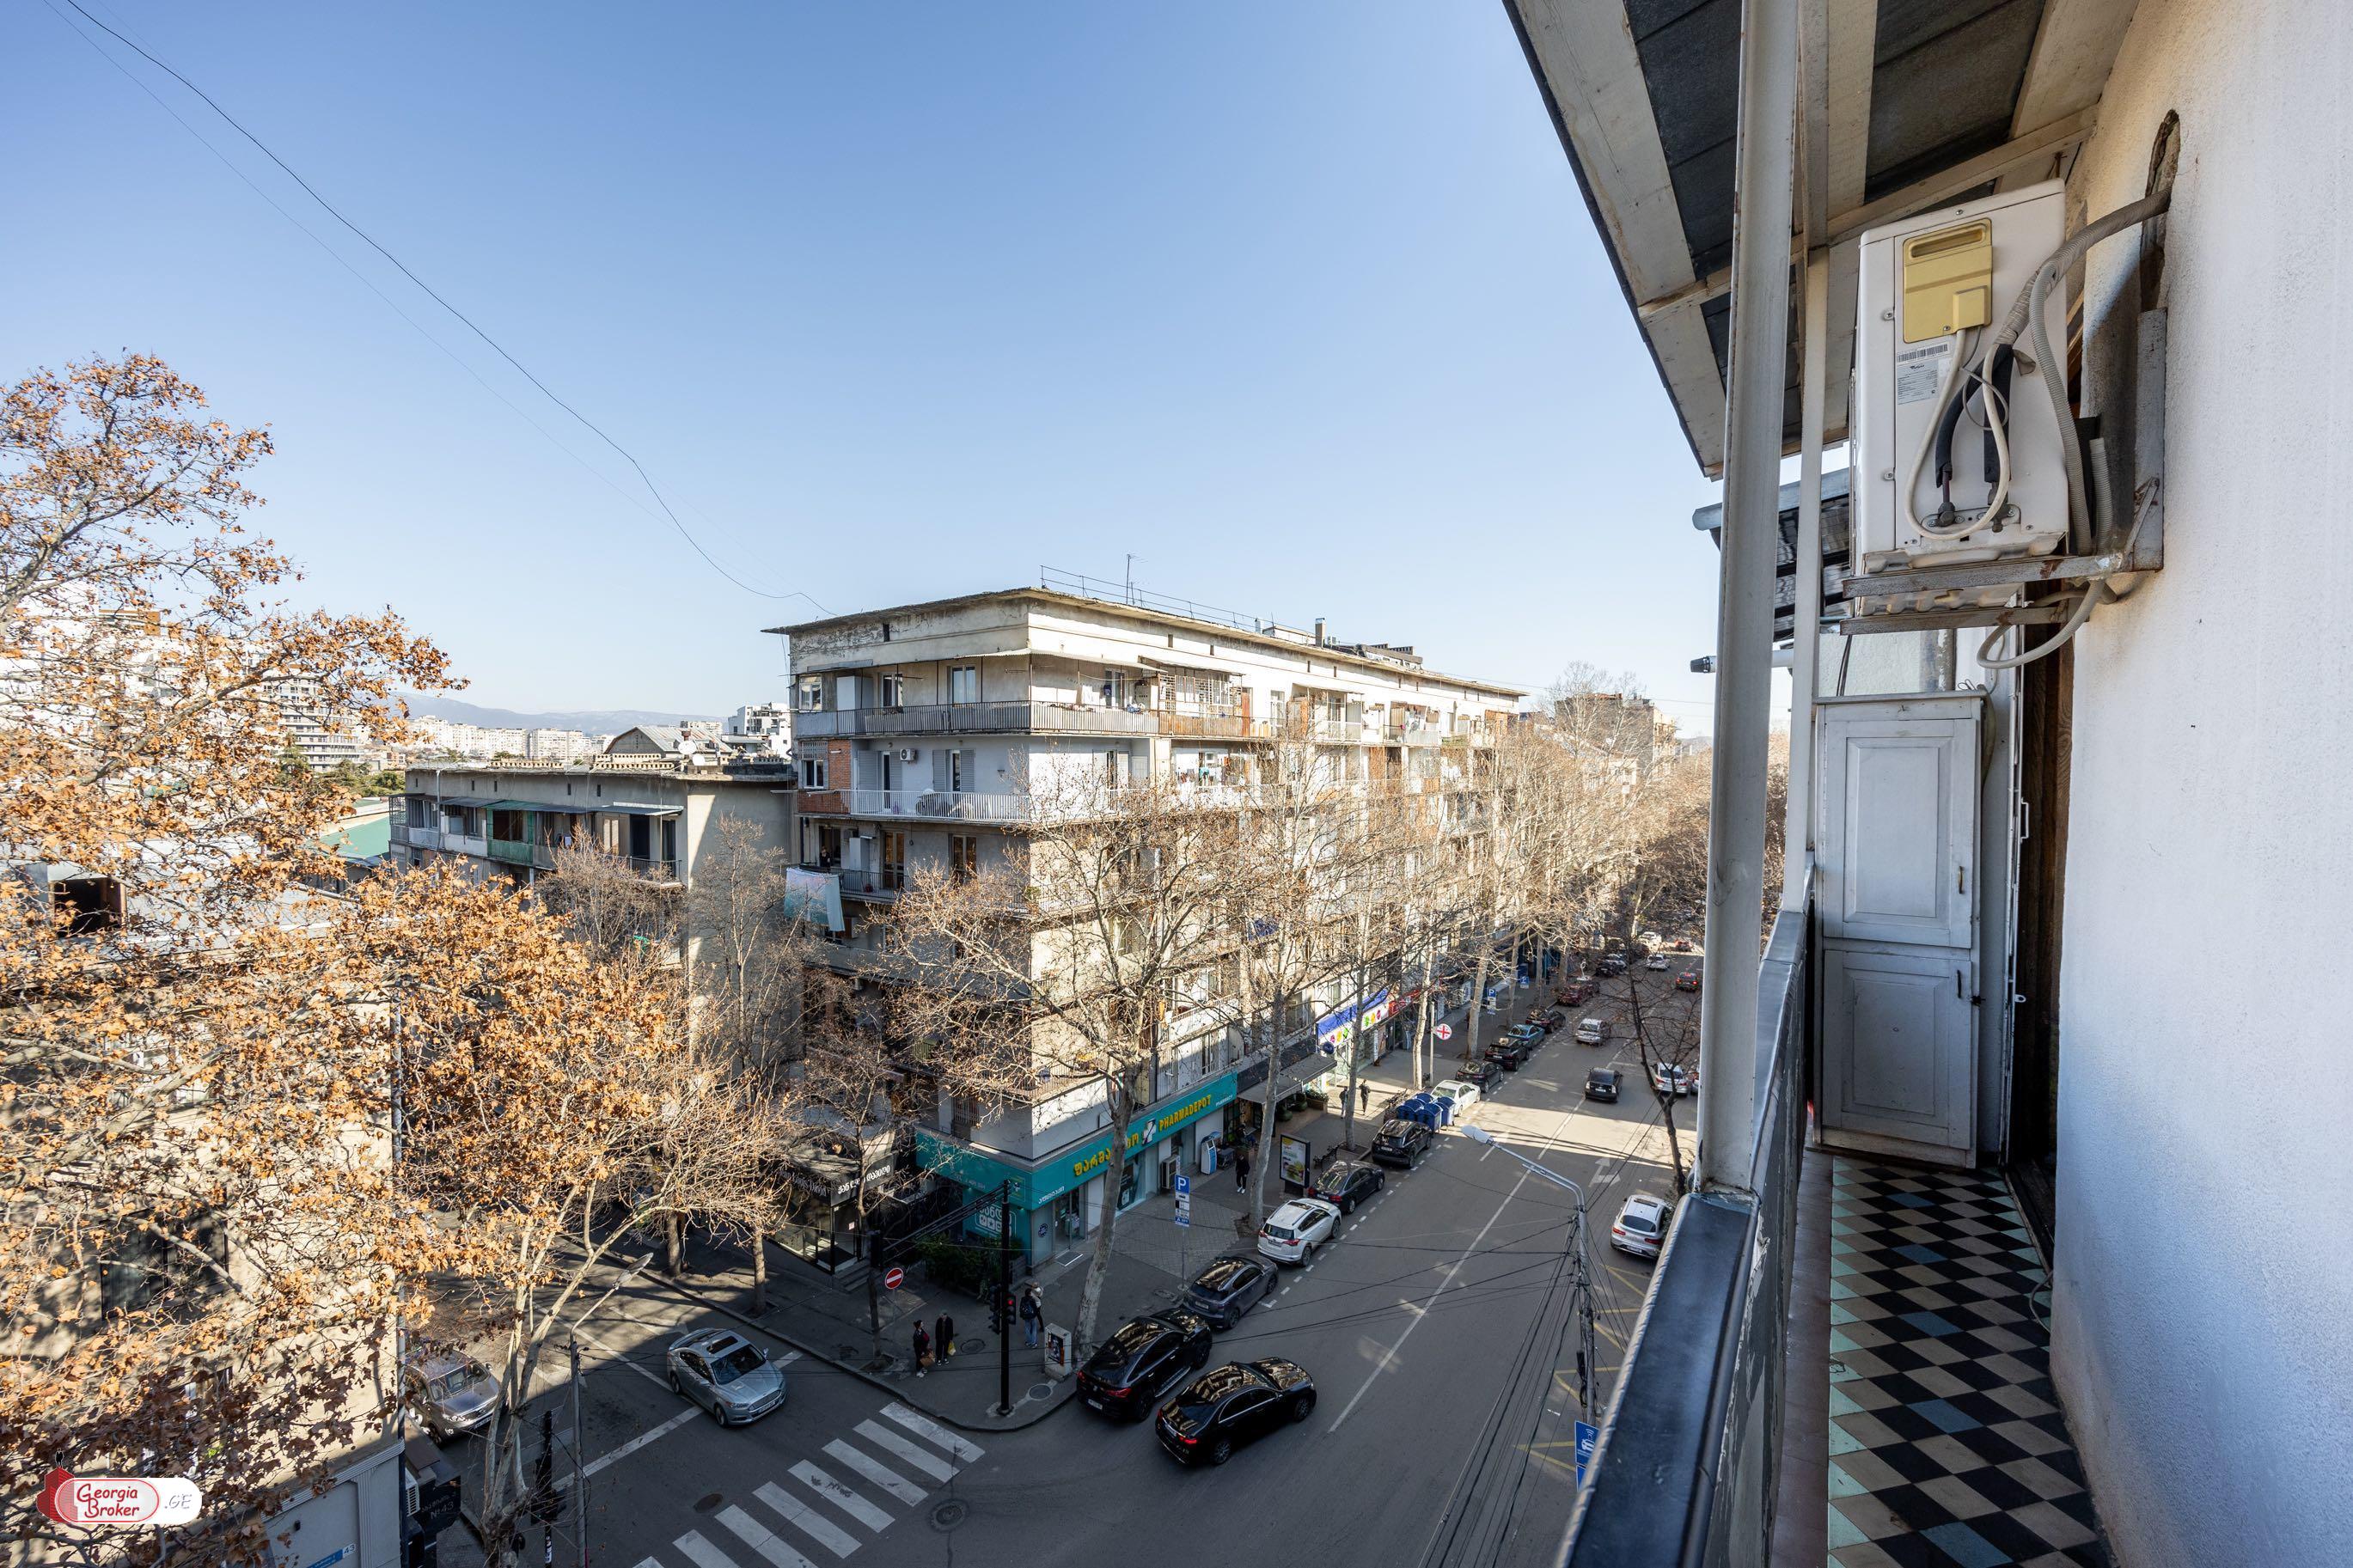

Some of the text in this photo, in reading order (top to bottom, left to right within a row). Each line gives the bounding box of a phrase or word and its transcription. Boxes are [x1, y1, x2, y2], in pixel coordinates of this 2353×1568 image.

[1158, 1095, 1212, 1132] PHARMADEPOT
[1177, 1177, 1186, 1190] P
[344, 1544, 355, 1554] 43
